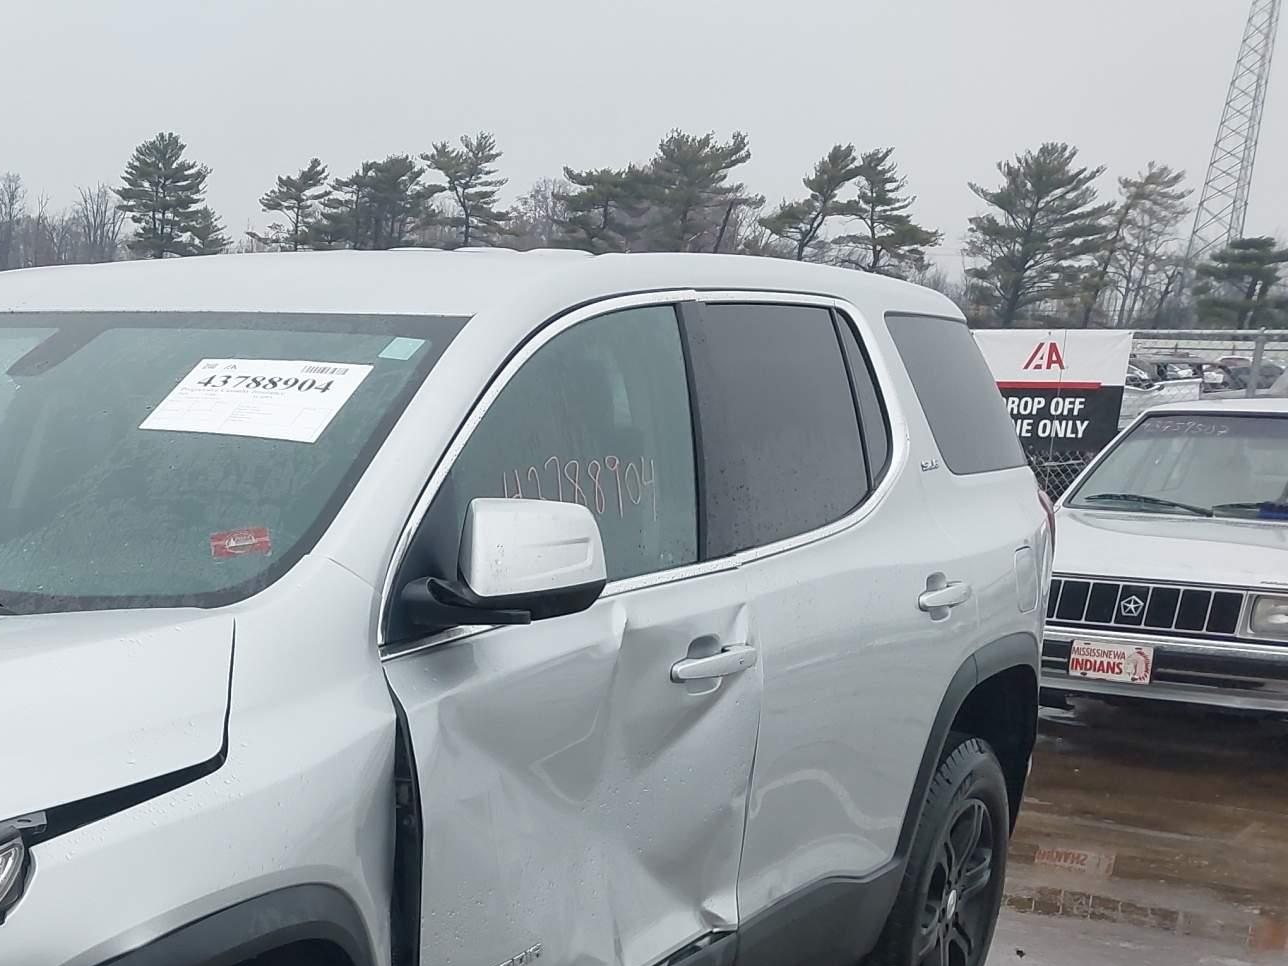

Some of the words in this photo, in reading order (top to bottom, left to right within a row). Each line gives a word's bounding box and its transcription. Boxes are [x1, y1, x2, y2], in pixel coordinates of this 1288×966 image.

[197, 374, 335, 393] 43788904
[1003, 397, 1045, 415] ROP
[1050, 397, 1086, 416] OFF
[1038, 419, 1089, 438] ONLY
[1071, 646, 1125, 660] MISSISSINEWA
[1070, 657, 1123, 675] INDIANS
